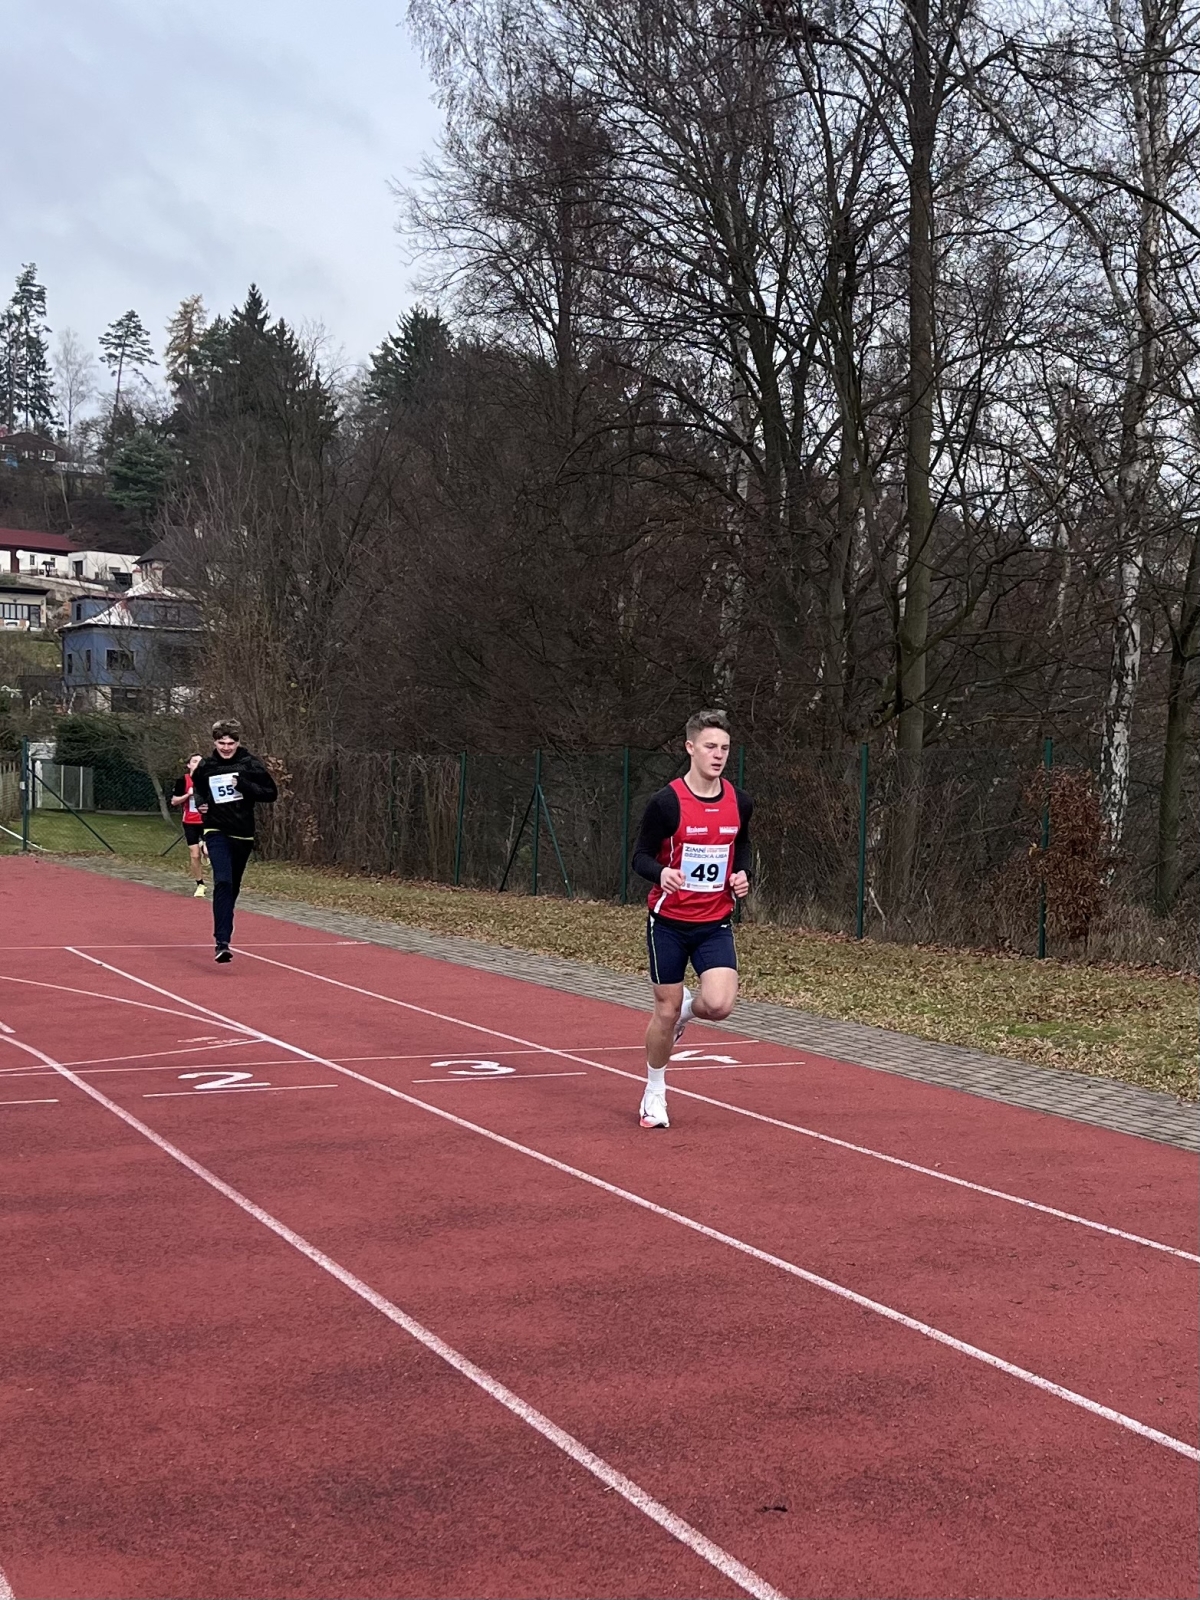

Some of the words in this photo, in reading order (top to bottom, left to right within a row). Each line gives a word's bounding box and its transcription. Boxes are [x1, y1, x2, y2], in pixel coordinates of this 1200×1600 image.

[218, 785, 234, 797] 55
[690, 863, 719, 882] 49
[430, 1060, 516, 1076] 3
[177, 1071, 271, 1090] 2
